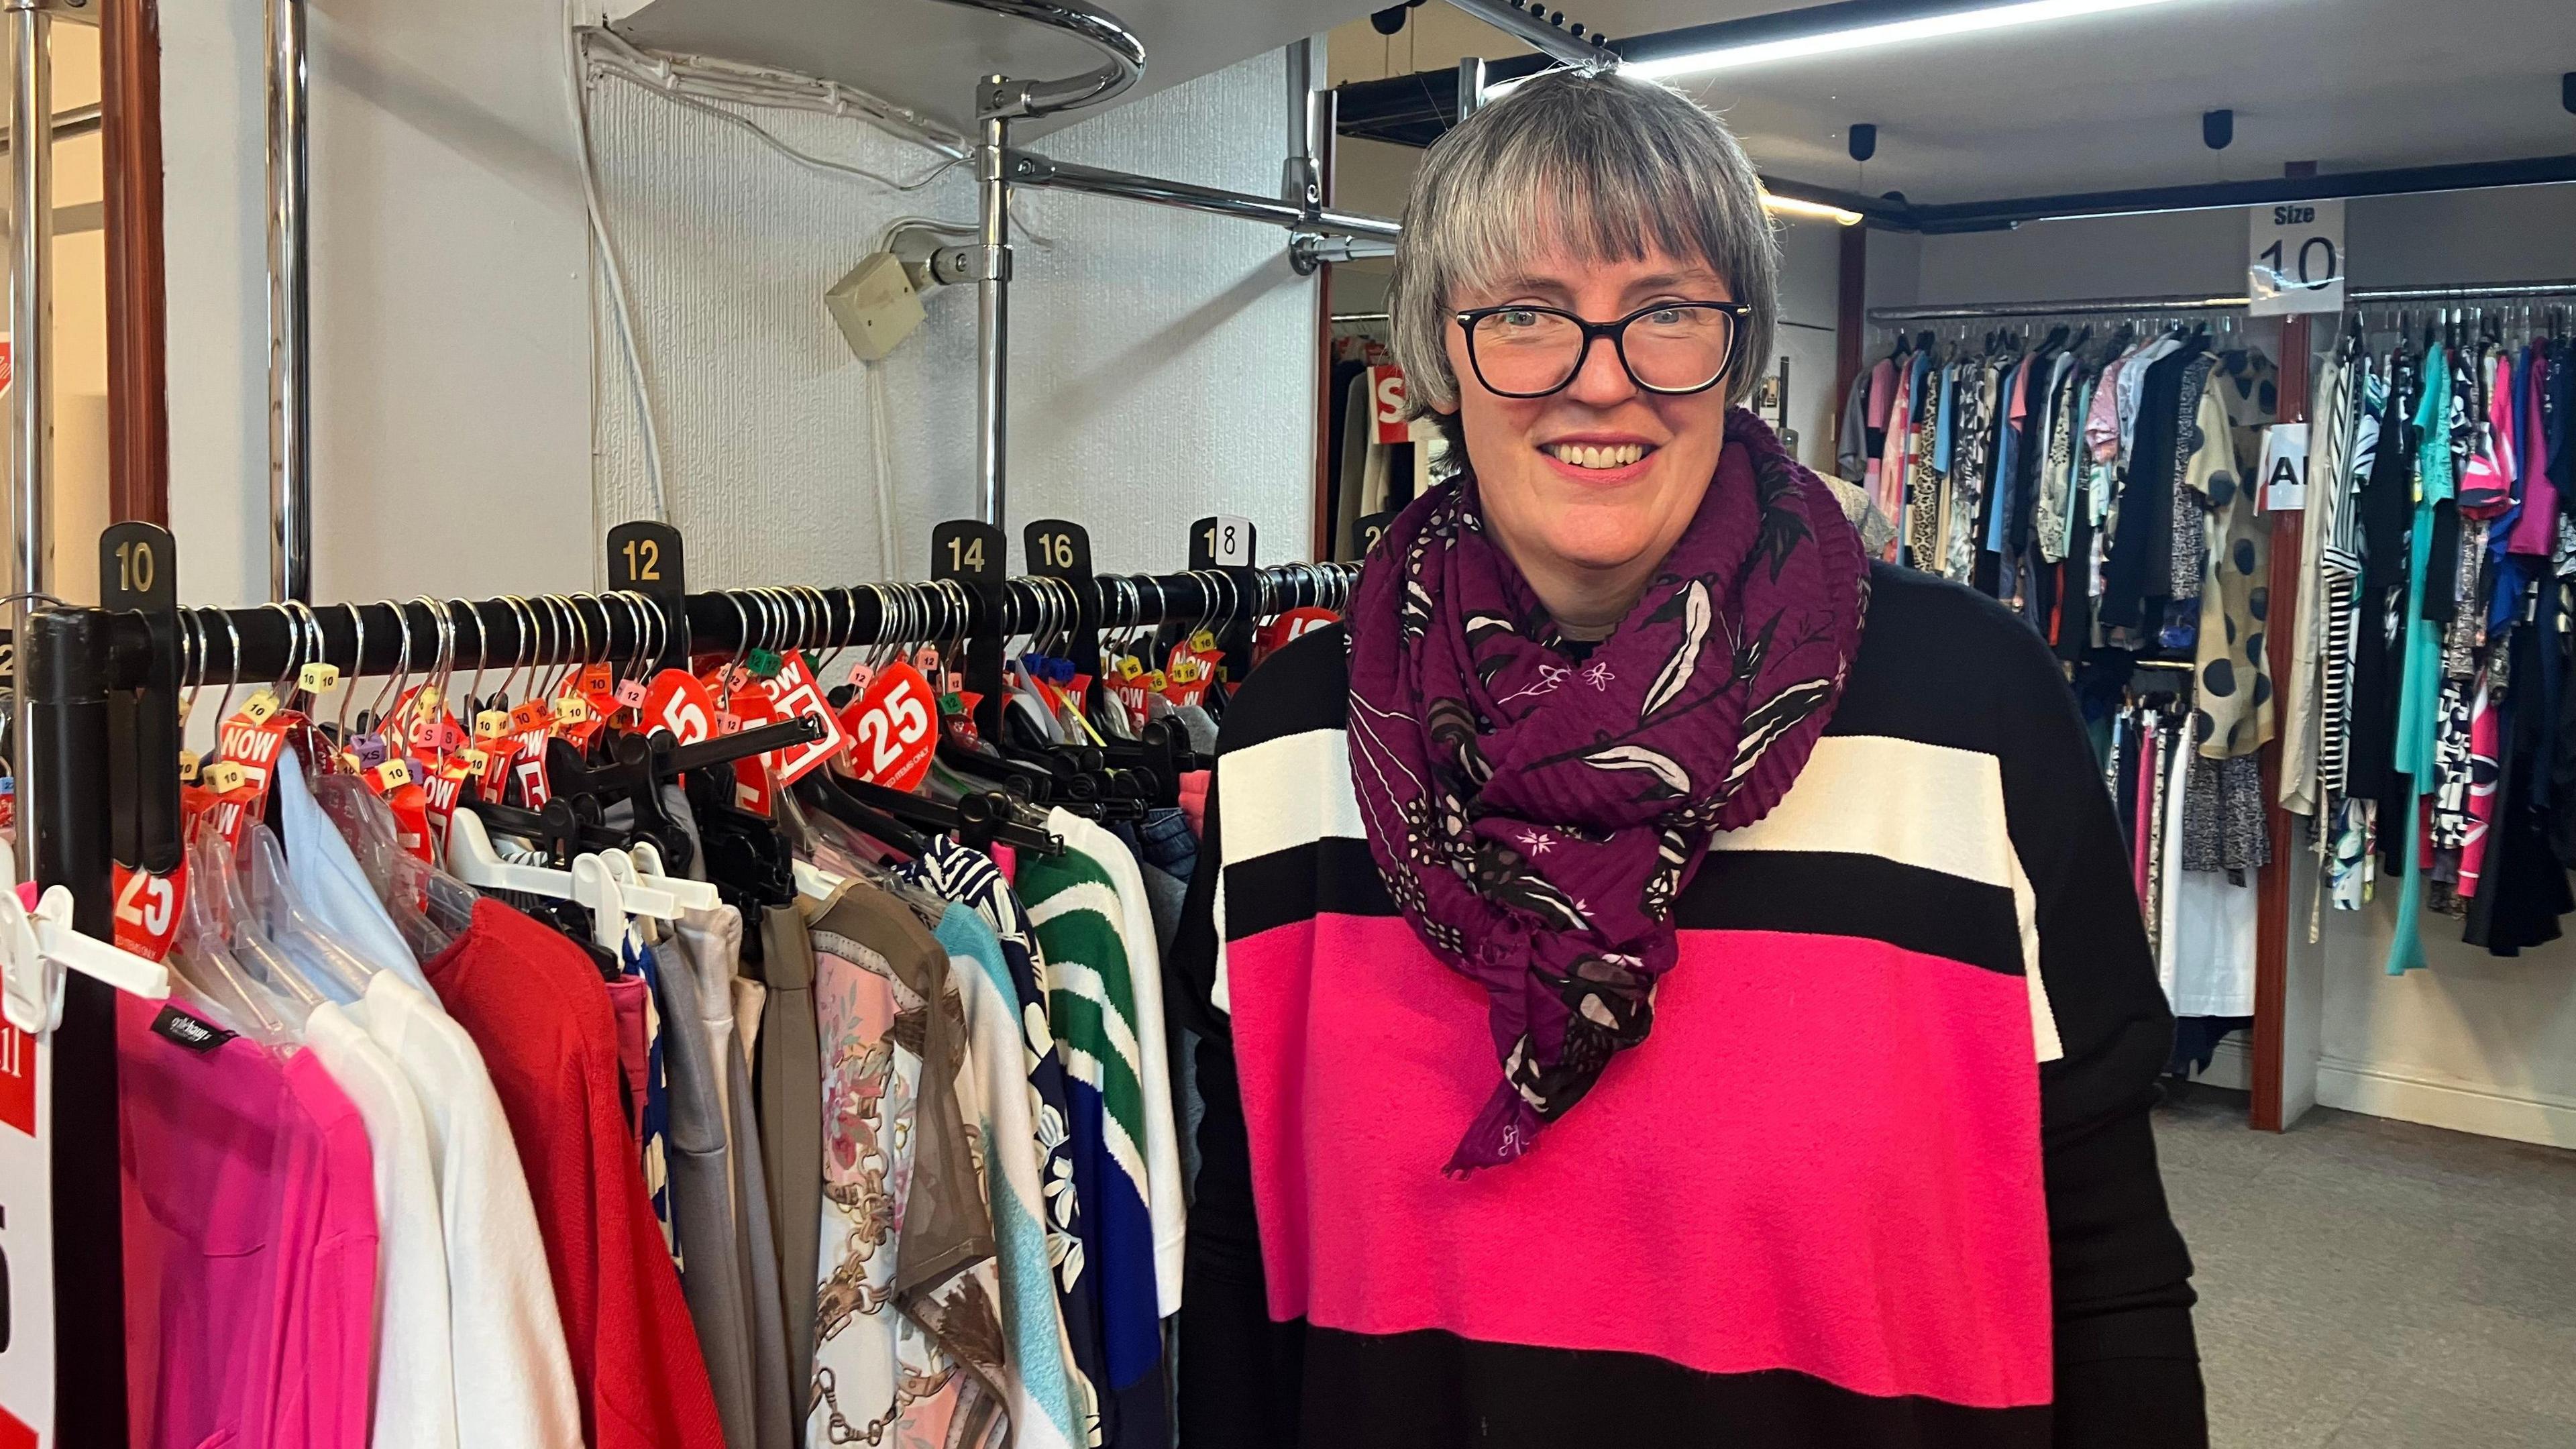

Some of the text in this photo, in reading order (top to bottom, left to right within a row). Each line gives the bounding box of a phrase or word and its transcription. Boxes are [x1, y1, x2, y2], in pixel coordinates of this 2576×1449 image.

[2274, 205, 2315, 225] Size
[2261, 237, 2336, 291] 10
[1203, 526, 1235, 557] 18
[1365, 525, 1391, 554] 2
[948, 537, 984, 572] 14
[1039, 533, 1073, 568] 16
[623, 539, 659, 580] 12
[116, 541, 154, 592] 10
[924, 657, 934, 665] 12
[304, 674, 314, 684] 10
[855, 673, 865, 683] 12
[1185, 669, 1195, 678] 16
[323, 676, 333, 687] 10
[590, 680, 605, 690] 10
[730, 676, 741, 686] 12
[761, 661, 802, 702] OW
[952, 680, 960, 688] 12
[1152, 677, 1163, 688] 16
[627, 691, 639, 701] 12
[1116, 686, 1144, 710] OW
[946, 698, 959, 709] 12
[250, 704, 265, 716] 10
[537, 705, 547, 717] 10
[570, 708, 581, 718] 10
[647, 686, 708, 746] 5
[516, 712, 530, 724] 10
[480, 720, 490, 731] 10
[499, 720, 506, 731] 10
[728, 721, 737, 730] 12
[424, 729, 433, 741] S
[445, 731, 453, 744] 8
[221, 727, 278, 762] NOW
[508, 729, 545, 760] OW
[362, 750, 380, 761] XS
[912, 745, 929, 764] ONLY
[472, 759, 482, 769] 10
[225, 772, 237, 784] 10
[388, 768, 403, 780] 10
[423, 775, 455, 810] OW
[115, 864, 173, 936] 25
